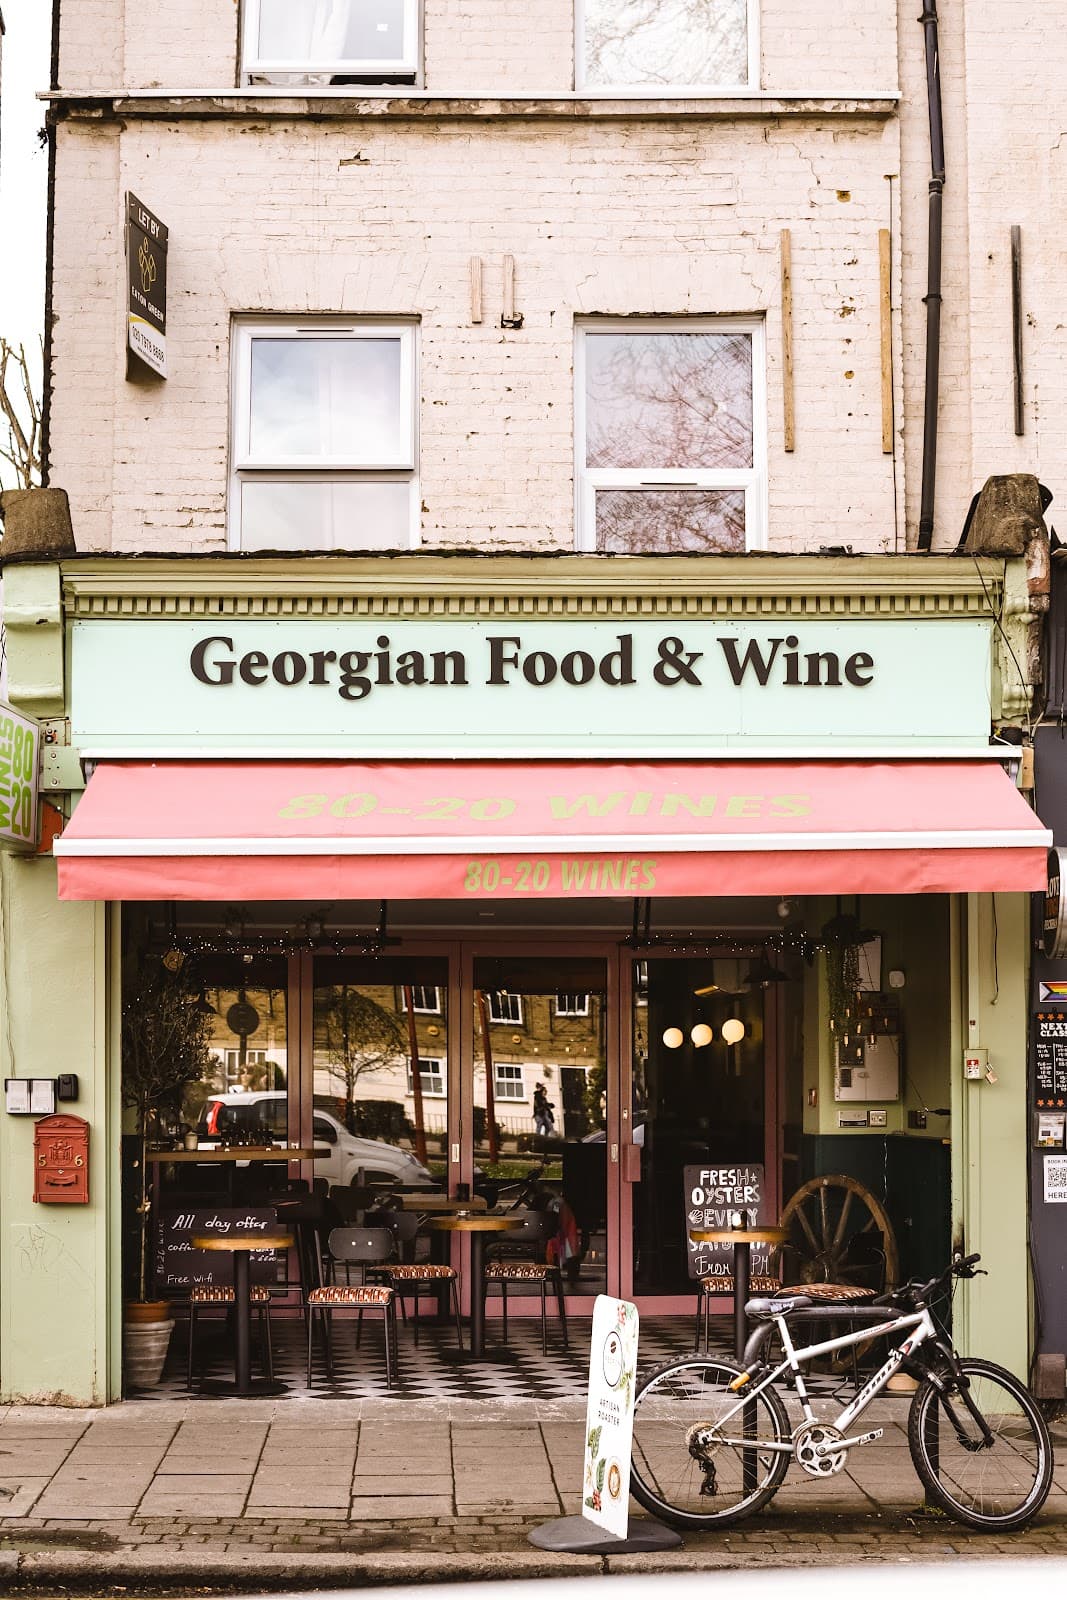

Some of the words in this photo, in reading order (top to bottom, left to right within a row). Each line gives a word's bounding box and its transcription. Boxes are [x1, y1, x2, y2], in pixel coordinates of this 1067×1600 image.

[138, 207, 150, 232] LET
[151, 220, 160, 239] BY
[132, 286, 146, 307] EATON
[147, 302, 164, 323] GREEN
[190, 635, 469, 700] Georgian
[486, 633, 637, 686] Food
[653, 635, 703, 686] &
[716, 634, 874, 686] Wine
[277, 792, 516, 821] 80-20
[549, 791, 814, 820] WINES
[464, 860, 550, 892] 80-20
[561, 857, 657, 892] WINES
[700, 1168, 749, 1186] FRESH
[691, 1184, 760, 1206] OYSTERS
[171, 1214, 196, 1231] All
[205, 1215, 231, 1233] day
[235, 1216, 268, 1230] offer
[167, 1274, 190, 1284] Free
